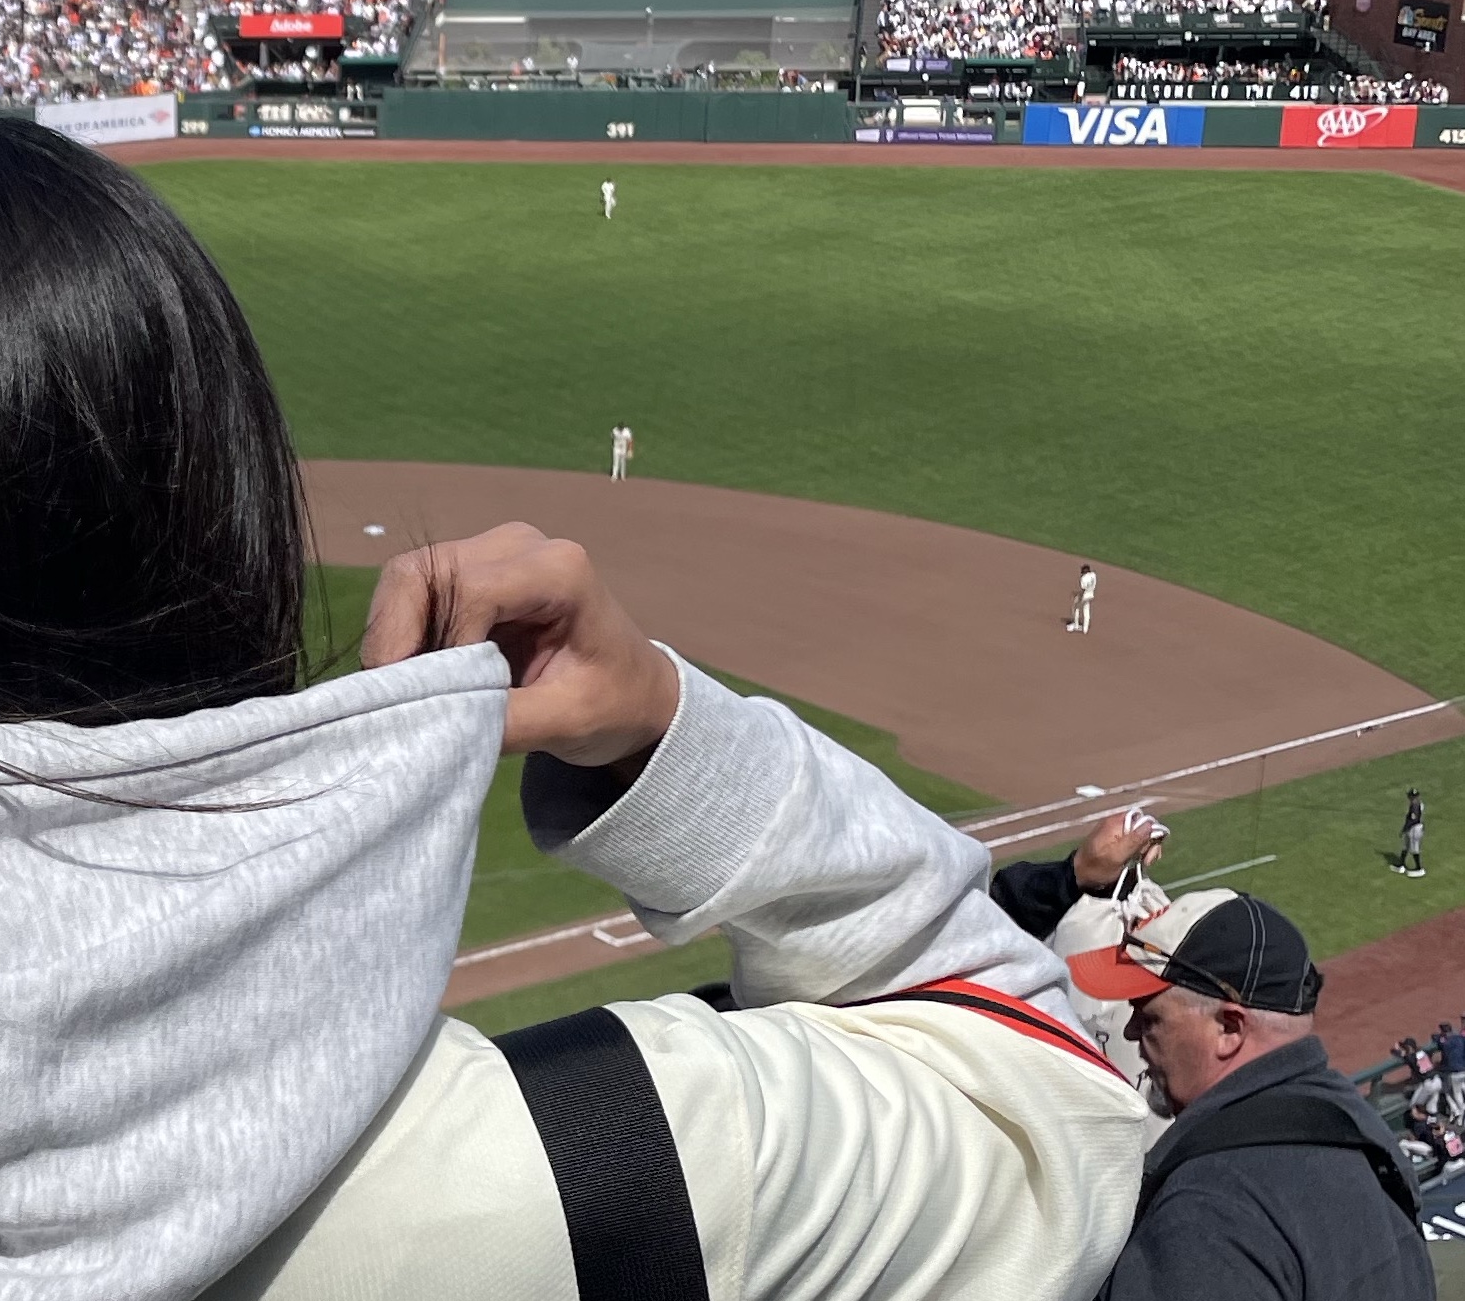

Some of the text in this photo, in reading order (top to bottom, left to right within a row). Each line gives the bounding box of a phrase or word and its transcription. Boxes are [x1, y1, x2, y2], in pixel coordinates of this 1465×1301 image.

[606, 121, 634, 139] 391
[1059, 107, 1168, 144] VISA
[1319, 108, 1366, 136] AAA
